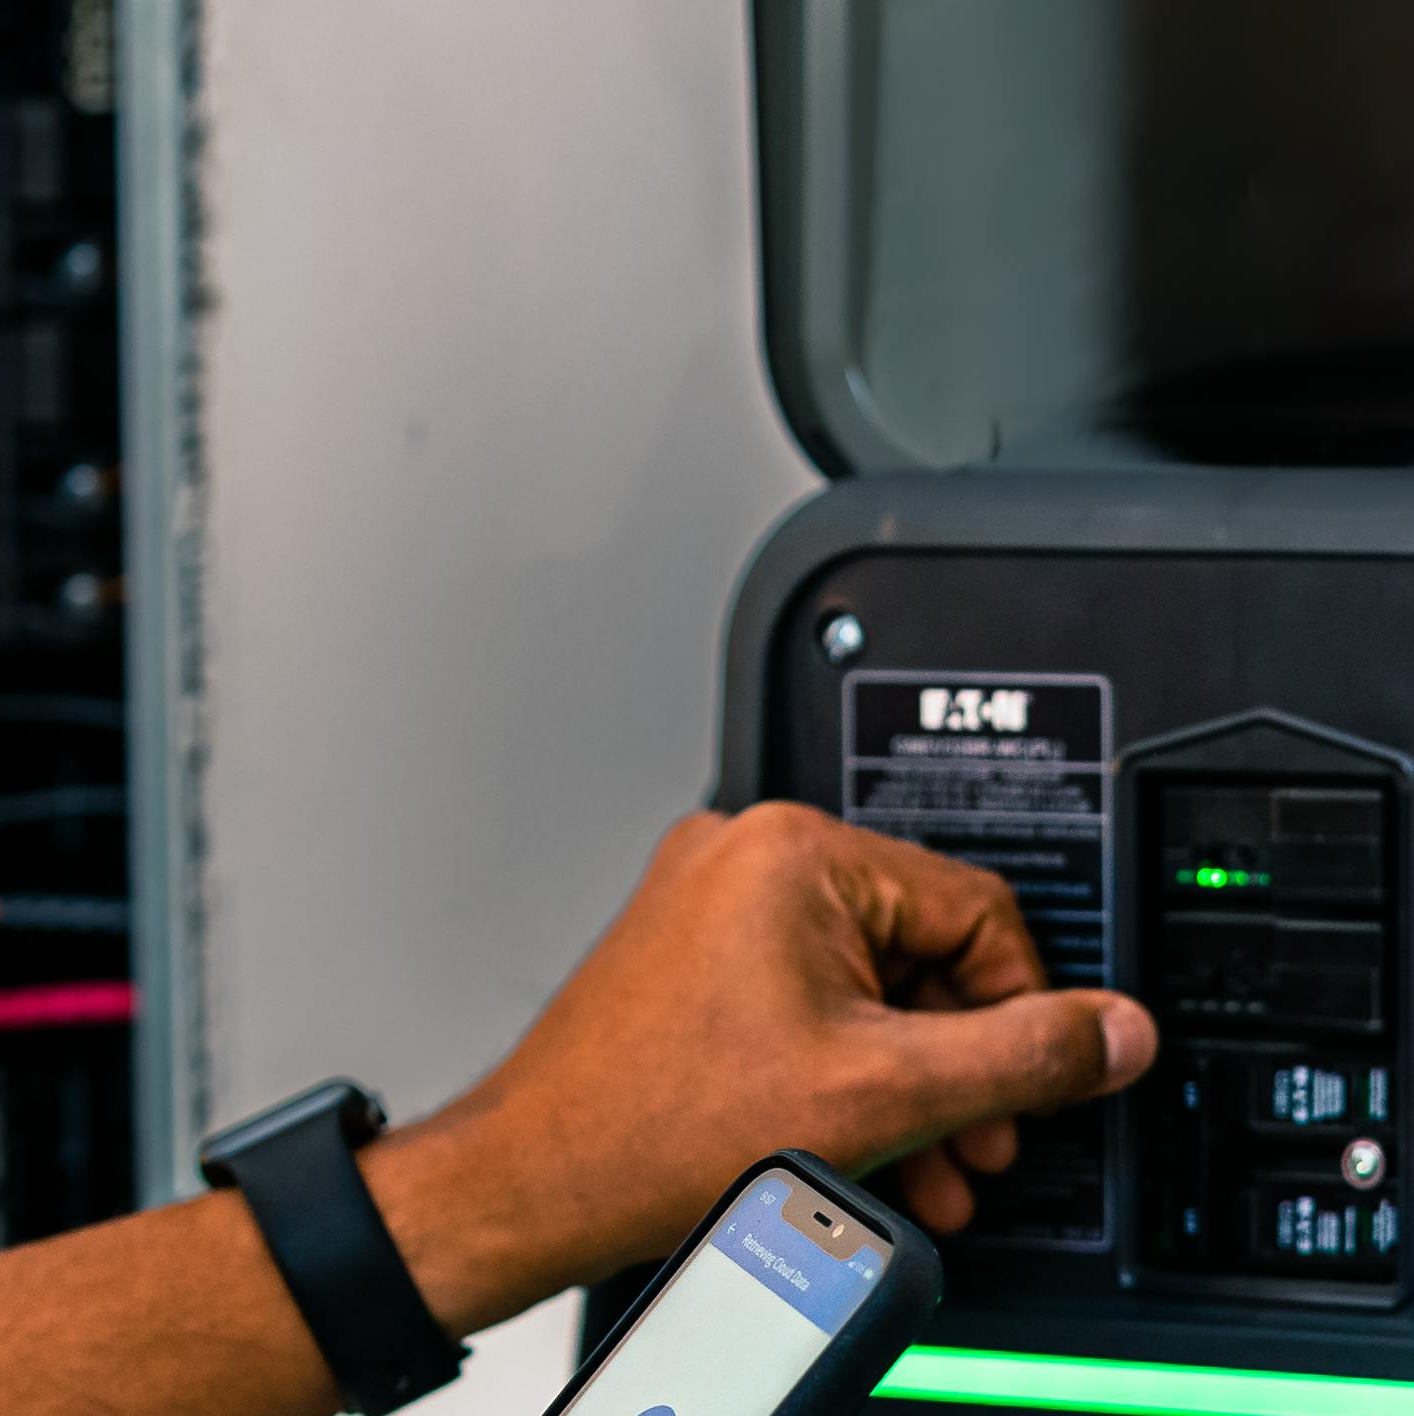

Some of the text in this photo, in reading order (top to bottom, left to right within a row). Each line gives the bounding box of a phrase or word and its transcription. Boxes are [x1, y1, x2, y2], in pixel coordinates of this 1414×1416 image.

[741, 1232, 811, 1292] Retrieving Cloud Data
